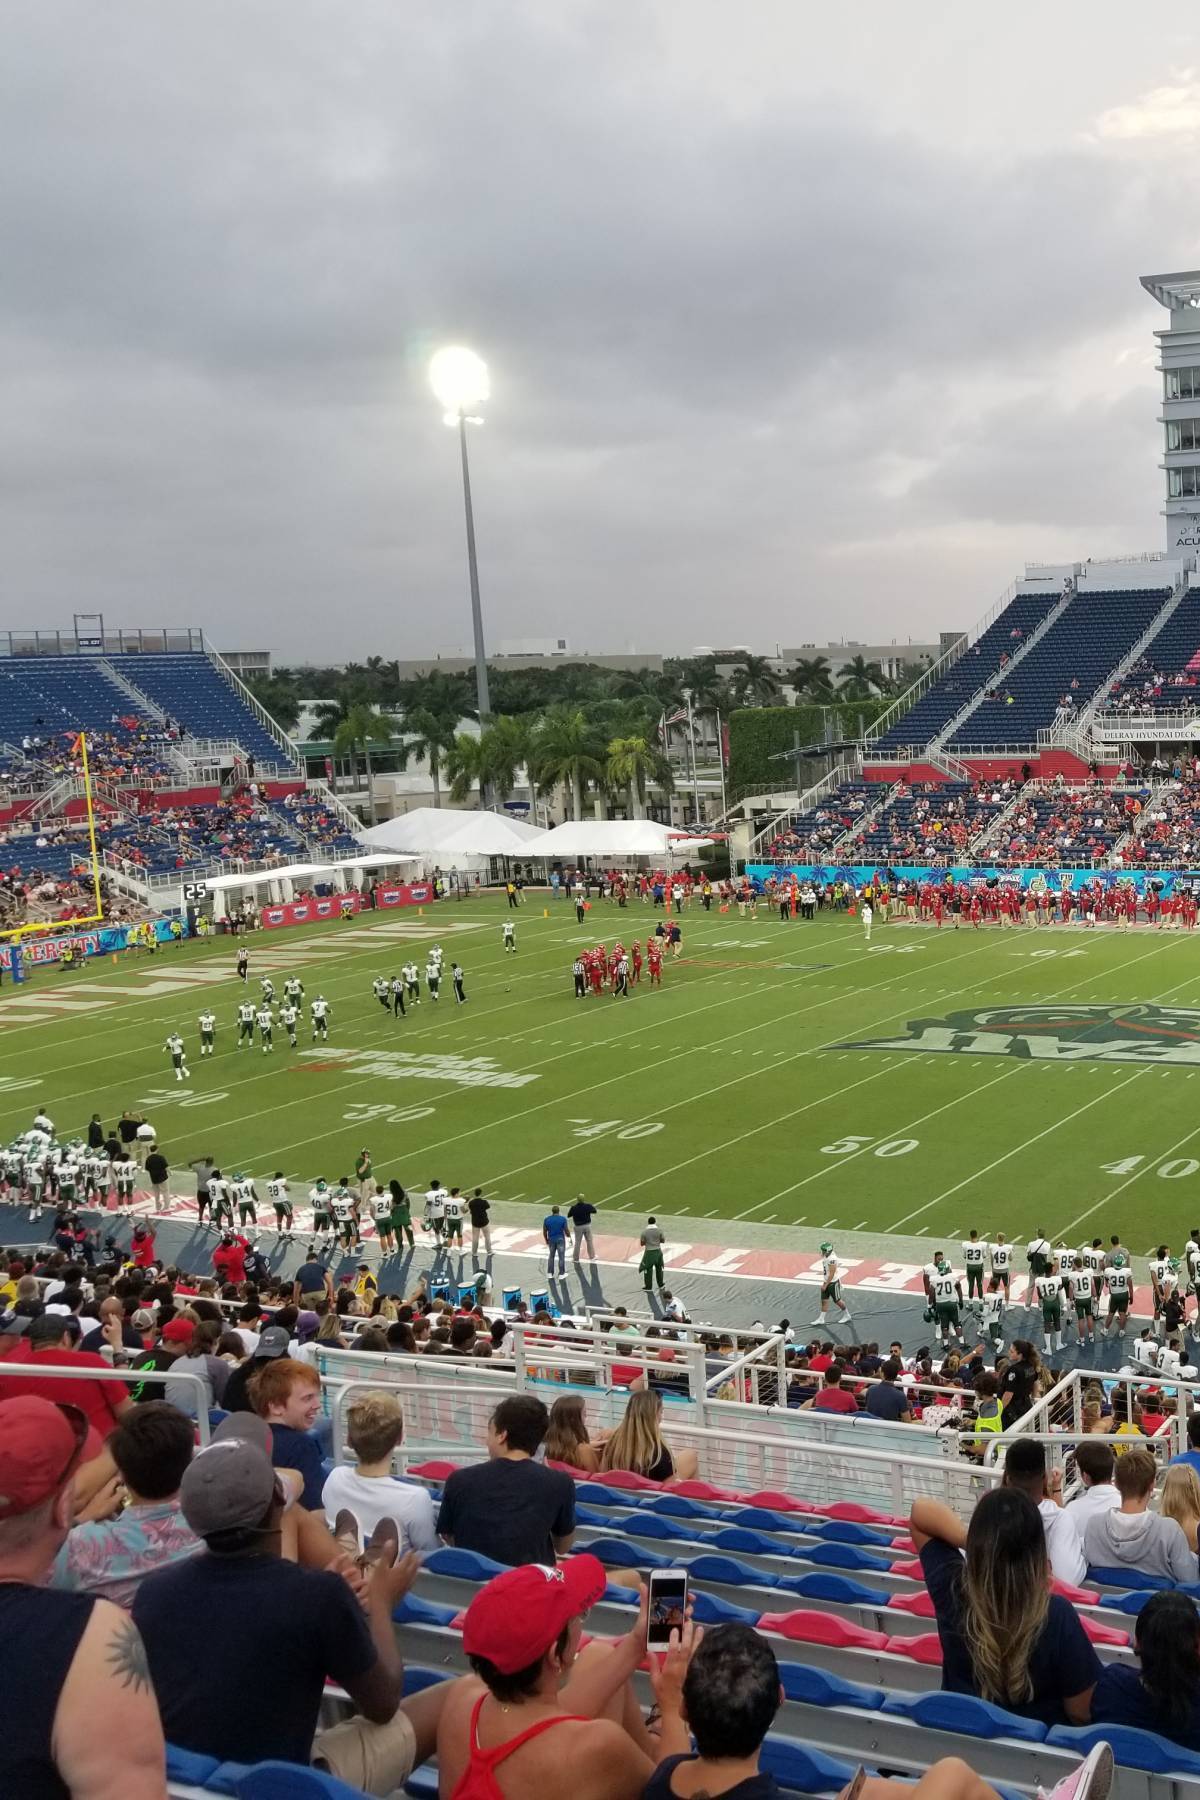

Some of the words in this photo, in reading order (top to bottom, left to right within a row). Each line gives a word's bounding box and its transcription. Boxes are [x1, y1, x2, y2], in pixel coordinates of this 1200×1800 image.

[1136, 731, 1173, 739] HYUNDAI
[186, 884, 206, 898] 25
[138, 1089, 230, 1107] 20
[342, 1104, 436, 1123] 30
[571, 1119, 665, 1139] 40
[819, 1135, 920, 1157] 50
[117, 1166, 130, 1177] 44
[1098, 1155, 1200, 1178] 40
[60, 1173, 73, 1182] 93
[238, 1188, 250, 1199] 14
[377, 1202, 390, 1213] 24
[967, 1249, 981, 1260] 23
[993, 1252, 1006, 1264] 49
[1060, 1255, 1073, 1269] 85
[1076, 1276, 1089, 1291] 16
[1110, 1275, 1125, 1287] 39
[936, 1281, 952, 1295] 70
[1042, 1284, 1055, 1296] 12
